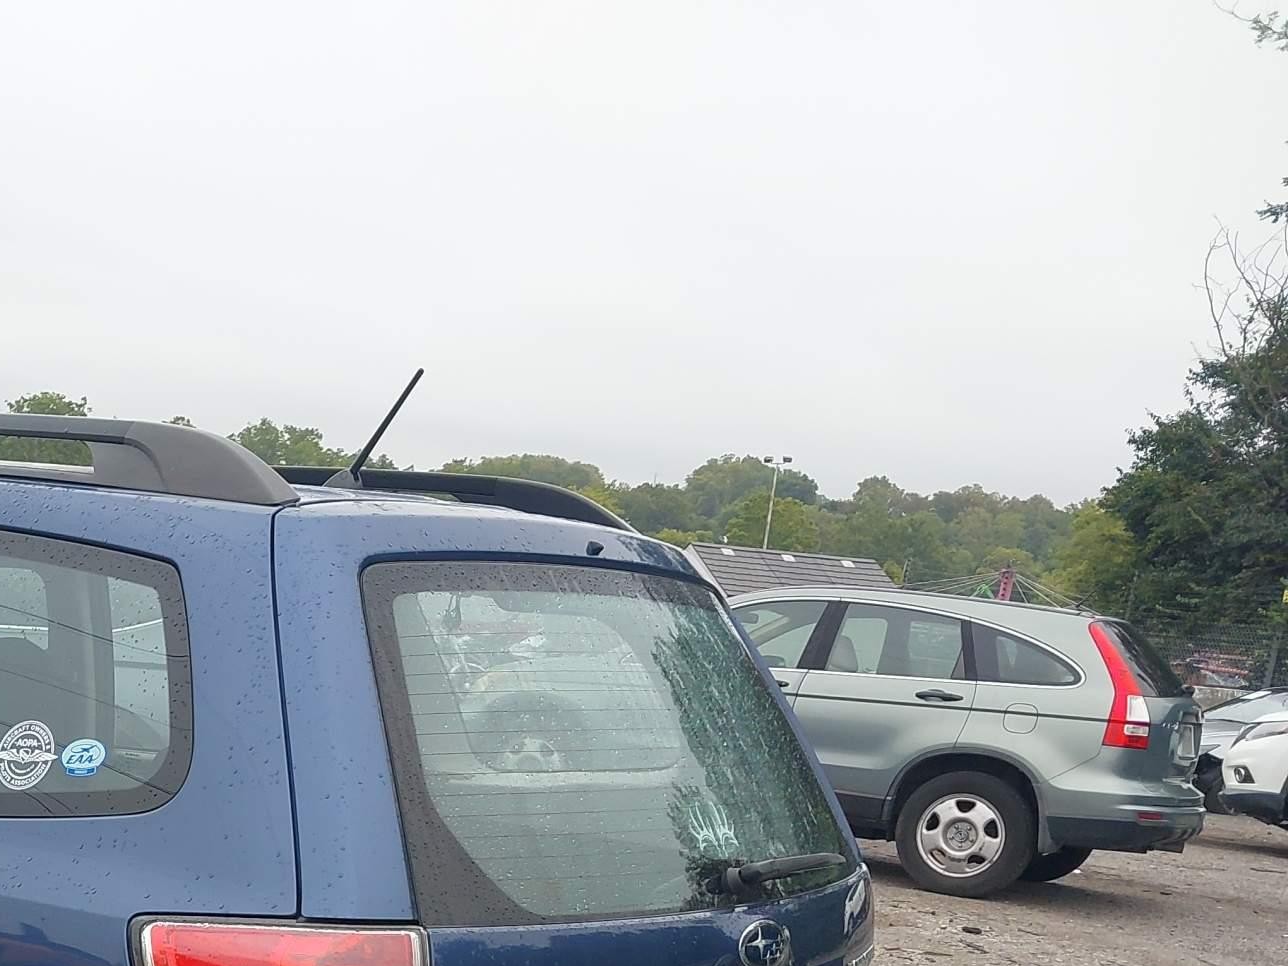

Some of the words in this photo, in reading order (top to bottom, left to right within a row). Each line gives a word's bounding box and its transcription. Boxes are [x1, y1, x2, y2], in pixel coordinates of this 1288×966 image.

[3, 725, 30, 748] AIRCRAFT
[66, 754, 94, 765] EAA
[10, 764, 47, 786] ASSOCIATION
